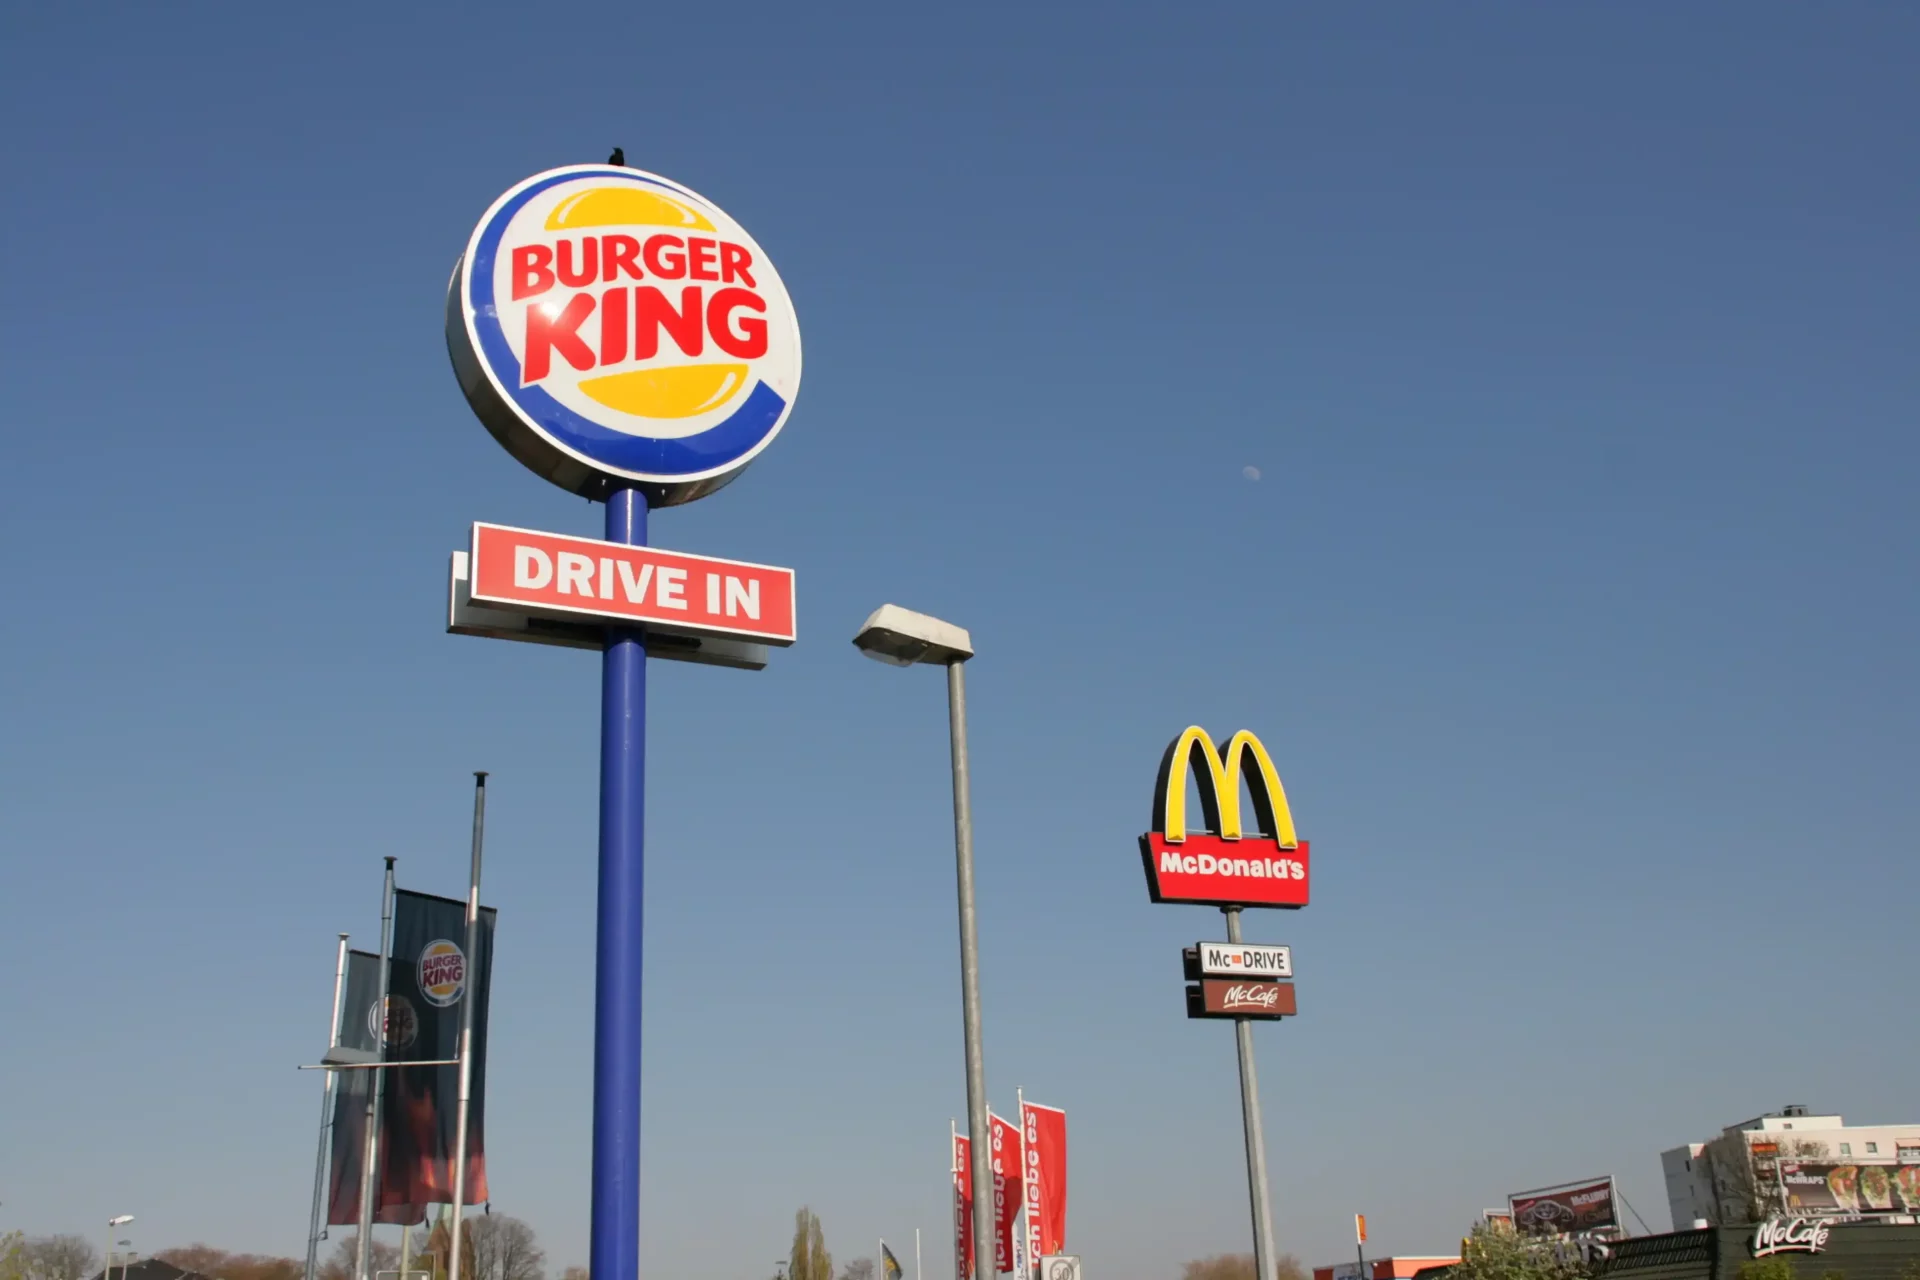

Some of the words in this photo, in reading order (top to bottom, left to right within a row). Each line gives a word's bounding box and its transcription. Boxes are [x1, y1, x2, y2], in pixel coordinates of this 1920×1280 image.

[512, 233, 757, 302] BURGER
[524, 285, 768, 384] KING
[514, 545, 688, 611] DRIVE
[706, 573, 760, 621] IN
[1160, 852, 1305, 880] McDonald's
[423, 954, 462, 971] BURGER
[1243, 951, 1285, 969] DRIVE
[423, 966, 463, 988] KING
[993, 1124, 1004, 1151] es
[1026, 1112, 1037, 1143] es
[1026, 1150, 1040, 1216] liebe
[1755, 1218, 1830, 1255] McCafé
